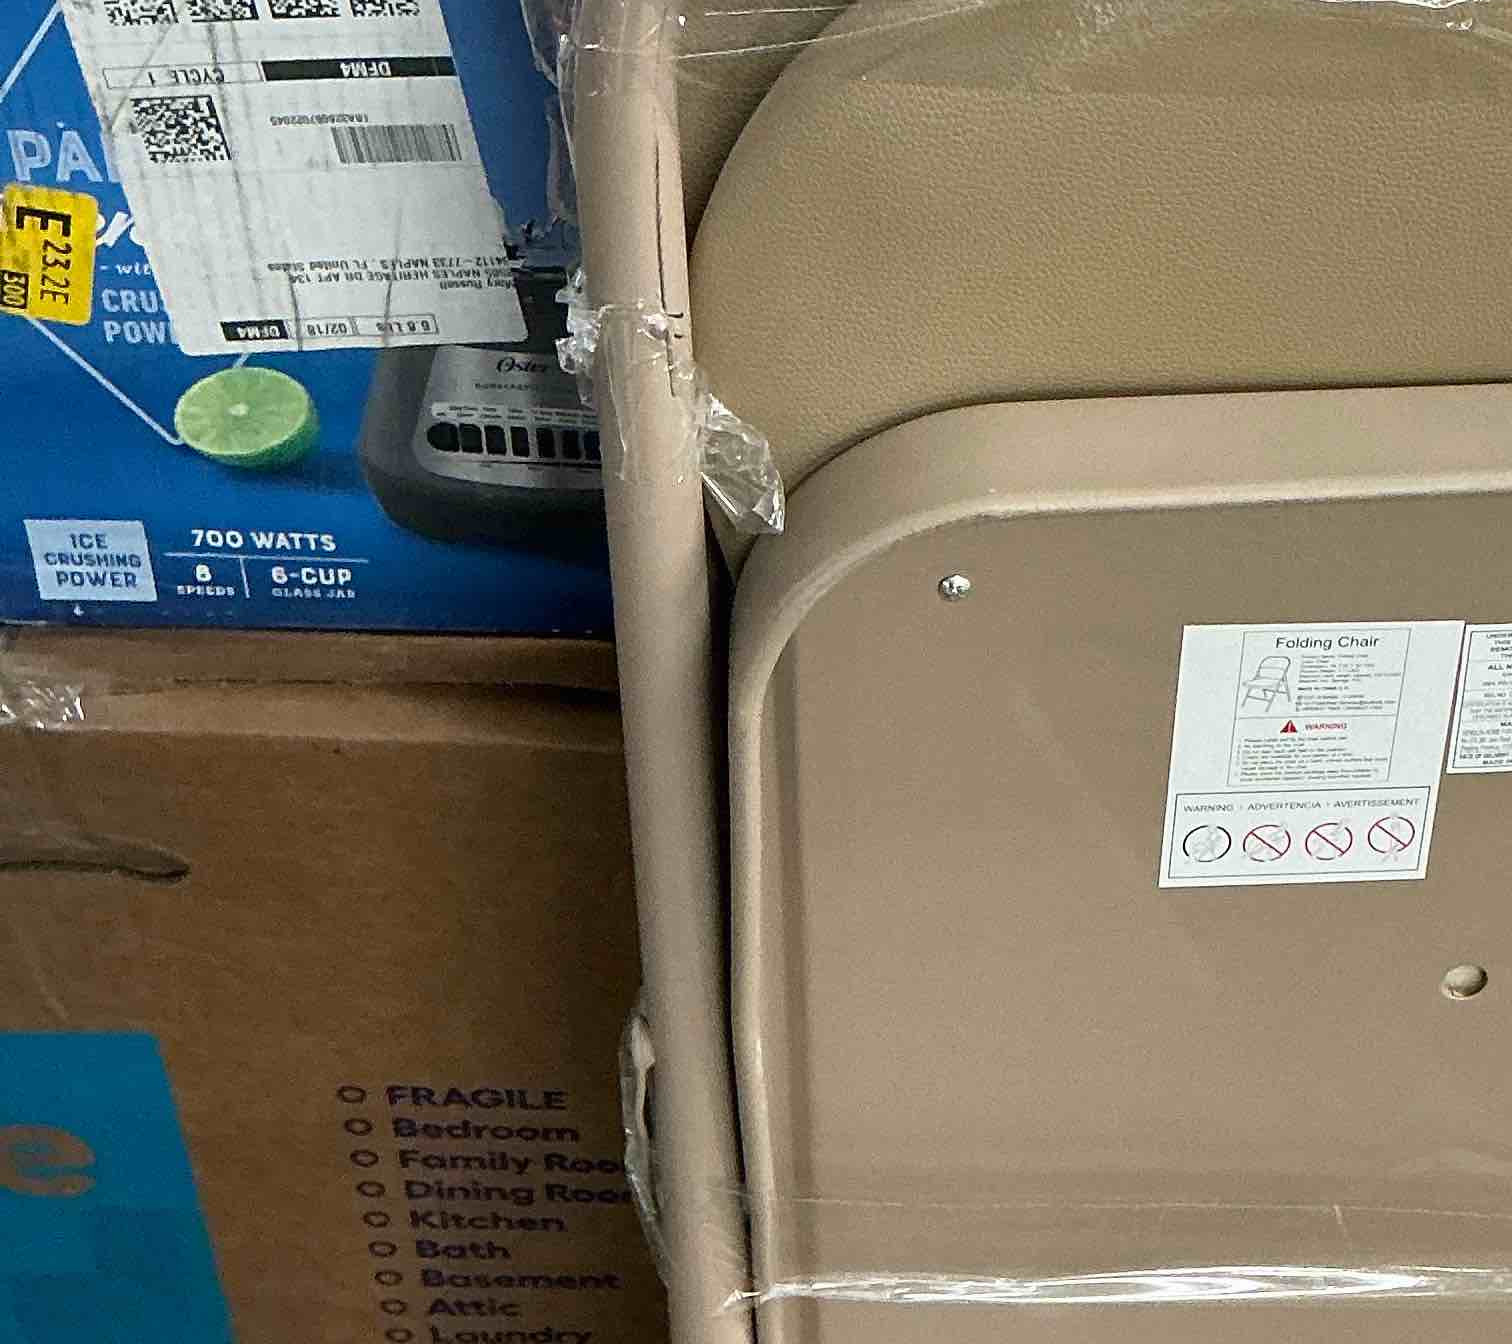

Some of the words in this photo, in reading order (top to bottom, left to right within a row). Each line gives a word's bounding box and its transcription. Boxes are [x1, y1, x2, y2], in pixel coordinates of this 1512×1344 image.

[174, 66, 226, 86] CYCLE
[338, 60, 392, 78] DFM4
[7, 121, 121, 182] PA
[16, 206, 73, 237] E
[40, 238, 73, 305] 23.2E
[316, 272, 340, 283] APT
[366, 270, 430, 282] HERITAGE
[432, 269, 482, 281] NAPLES
[3, 271, 26, 307] 300
[102, 288, 167, 313] CRU
[104, 320, 176, 345] POW
[70, 533, 108, 550] ICE
[191, 529, 244, 548] 700
[250, 532, 337, 552] WATTS
[43, 553, 142, 569] CRUSHING
[55, 571, 138, 589] POWER
[176, 584, 236, 597] SPEEDS
[1275, 636, 1333, 652] Folding
[1337, 635, 1381, 648] Chair
[1304, 722, 1348, 731] WARNING
[1183, 803, 1234, 813] WARNING
[1247, 800, 1322, 811] ADVERTENCIA
[1332, 798, 1421, 808] AVERTISSEMENT
[386, 1086, 568, 1110] FRAGILE
[391, 1117, 580, 1142] Bedroom
[399, 1149, 533, 1175] Family
[544, 1154, 627, 1174] Roo
[404, 1180, 535, 1206] Dining
[409, 1210, 568, 1233] Kitchen
[415, 1239, 511, 1259] Bath
[421, 1268, 623, 1290] Basement
[429, 1298, 522, 1317] Attic
